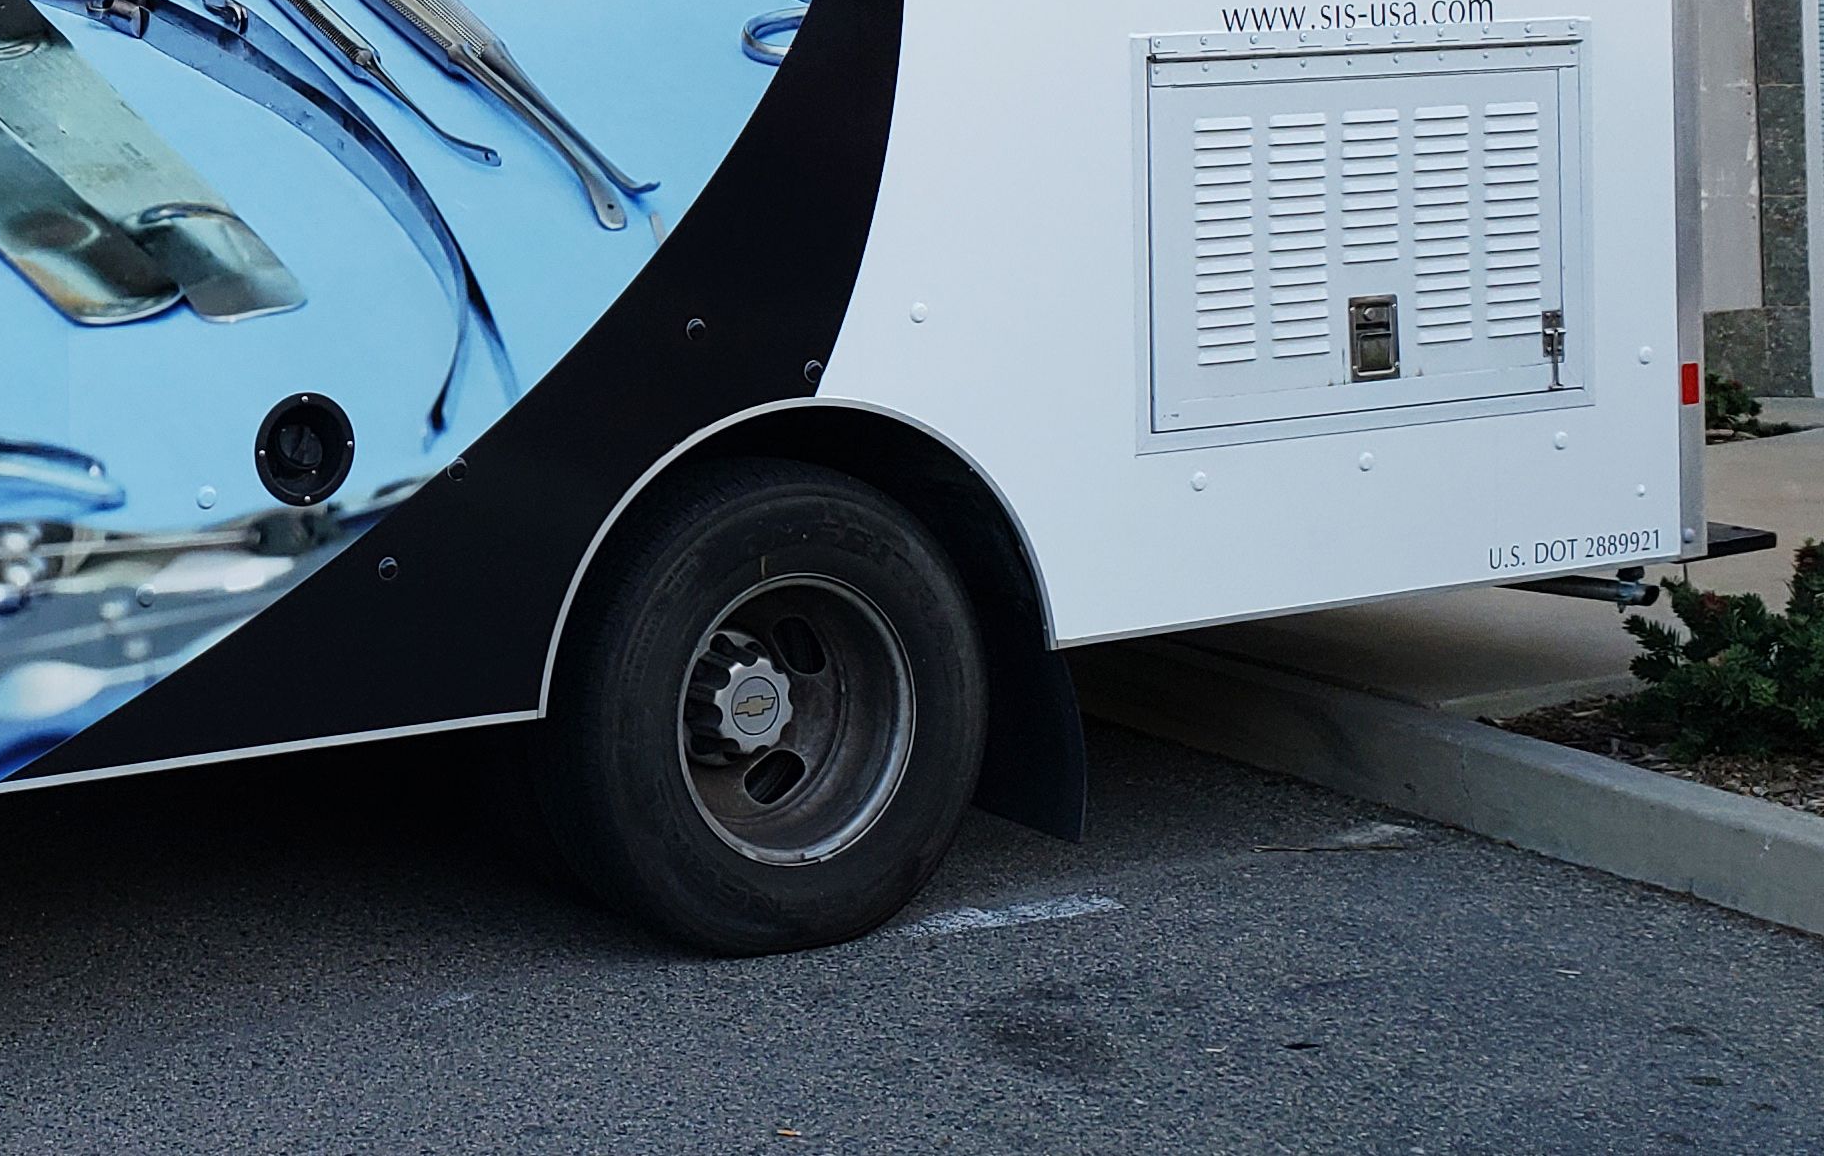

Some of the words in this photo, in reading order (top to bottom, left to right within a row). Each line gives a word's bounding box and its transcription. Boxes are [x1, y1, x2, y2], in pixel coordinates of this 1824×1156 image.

[1489, 545, 1526, 570] U.S.
[1534, 538, 1578, 564] DOT
[1584, 528, 1661, 558] 2889921
